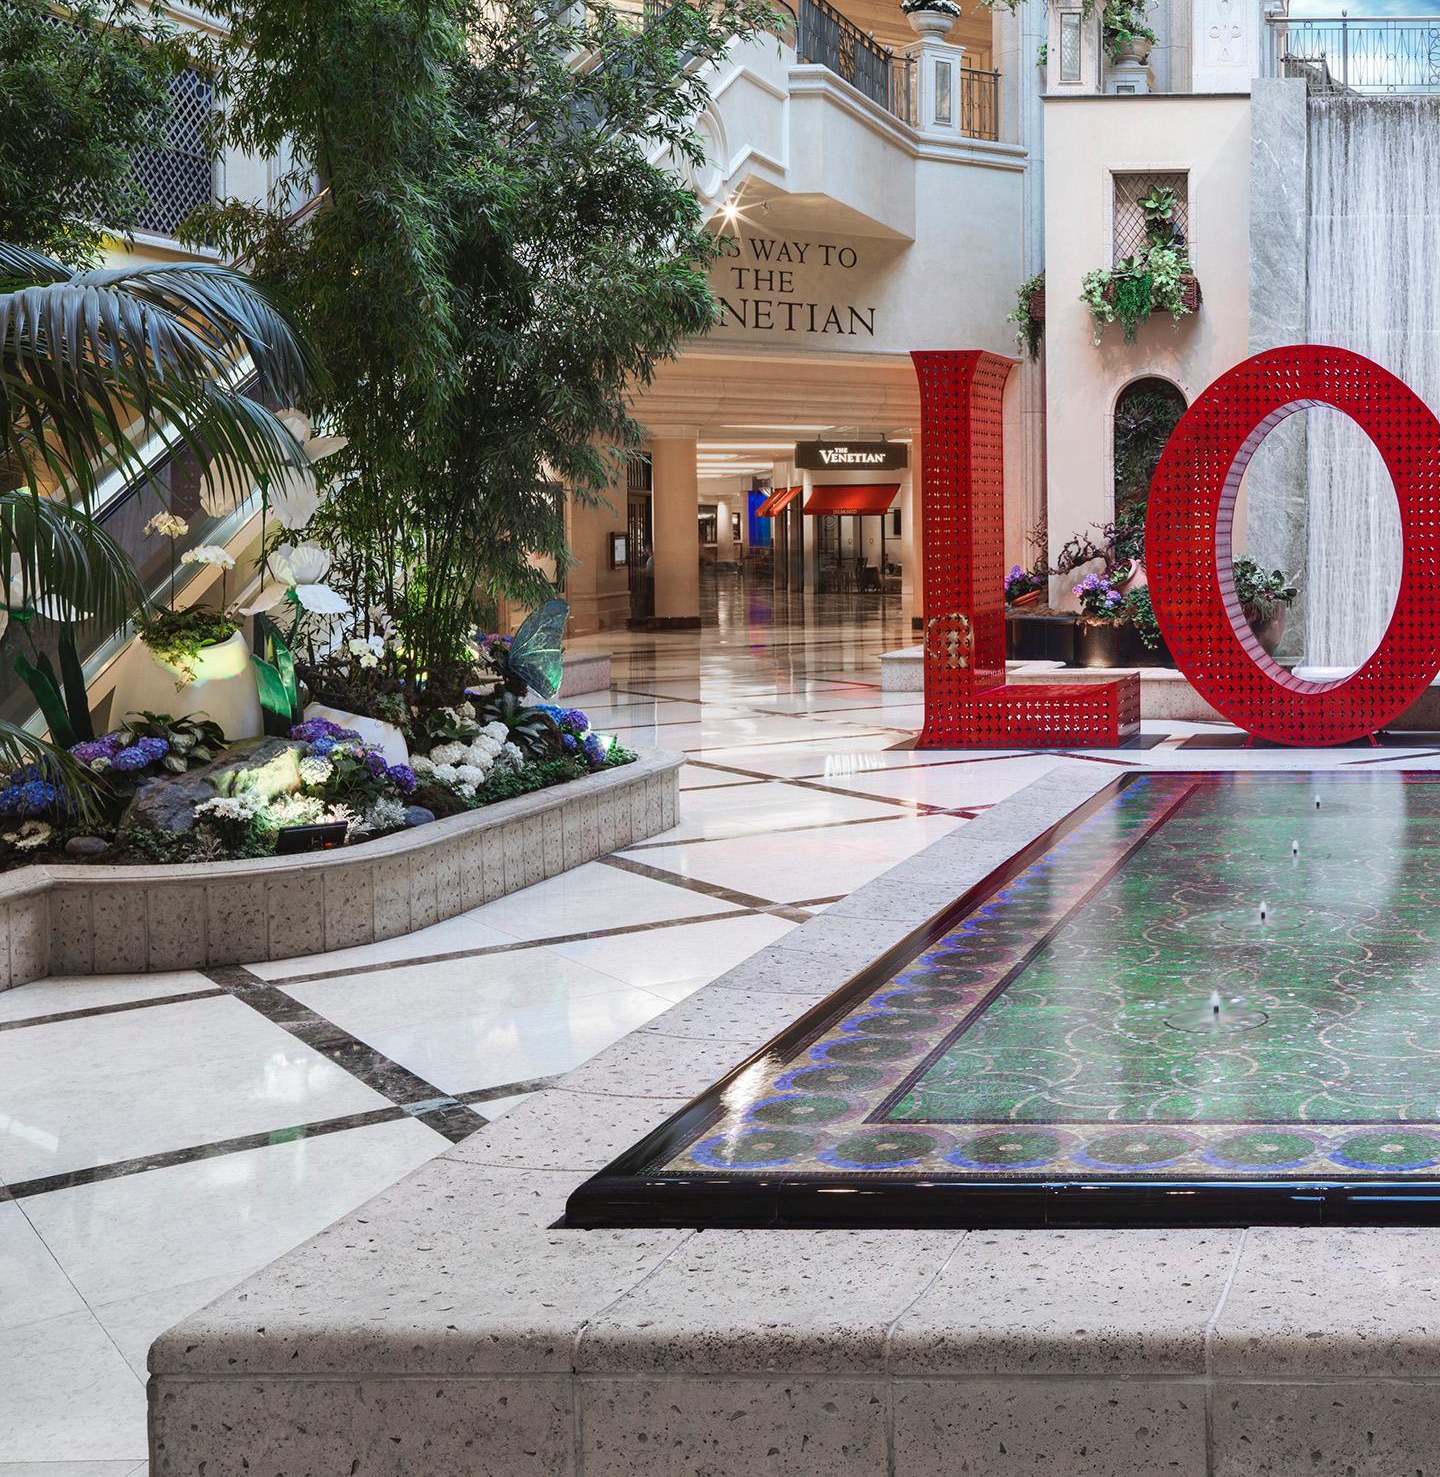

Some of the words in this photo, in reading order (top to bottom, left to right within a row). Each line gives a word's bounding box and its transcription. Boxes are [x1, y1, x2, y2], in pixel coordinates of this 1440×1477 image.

[748, 237, 810, 264] WAY
[818, 244, 858, 269] TO
[730, 266, 794, 294] THE
